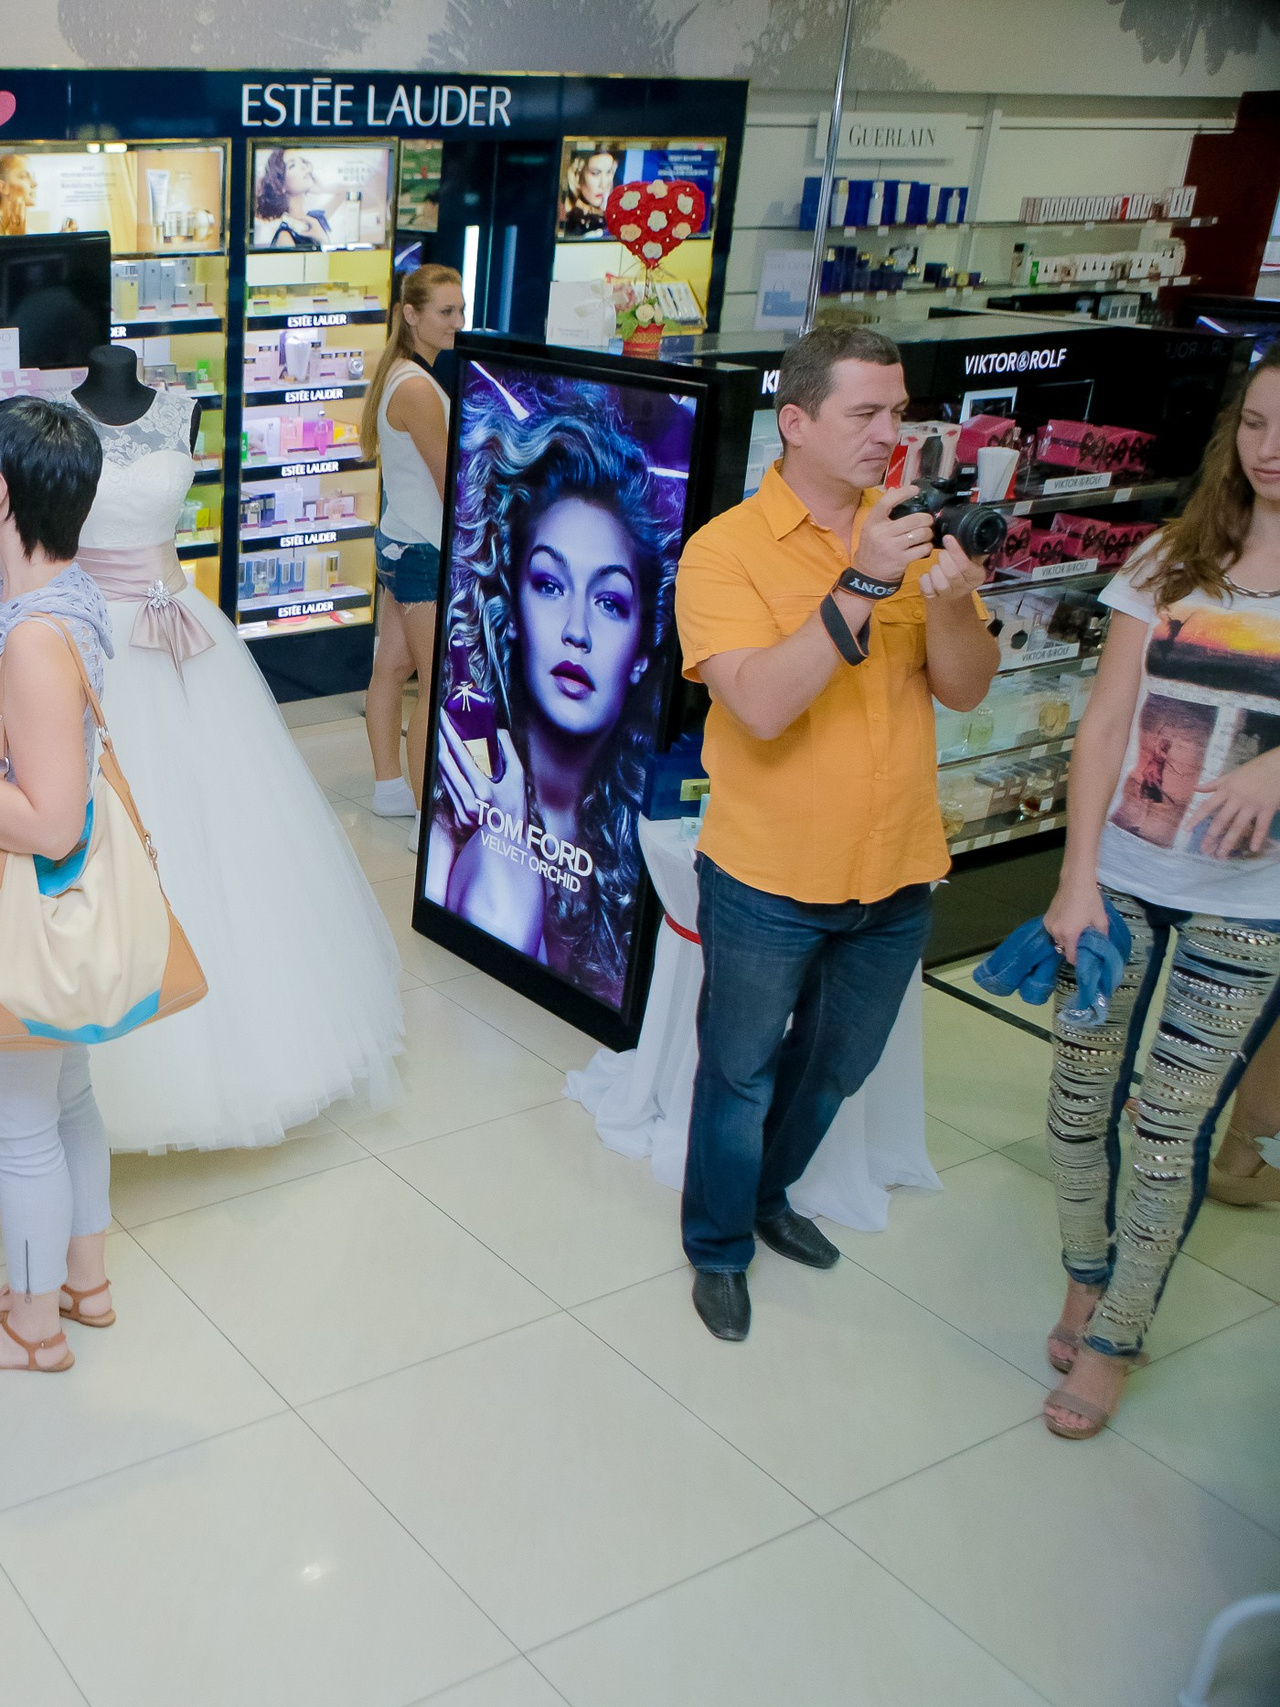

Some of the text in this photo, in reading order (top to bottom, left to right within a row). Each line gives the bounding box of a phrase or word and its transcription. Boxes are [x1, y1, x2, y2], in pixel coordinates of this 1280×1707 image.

[367, 84, 512, 127] LAUDER
[848, 124, 937, 148] GUERLAIN
[313, 314, 347, 326] LAUDER
[310, 388, 344, 400] LAUDER
[306, 461, 339, 474] LAUDER
[305, 532, 337, 545] LAUDER
[849, 578, 897, 595] SONY
[302, 601, 334, 615] LAUDER
[475, 799, 594, 877] TOM FORD
[480, 830, 581, 893] VELVET ORCHID
